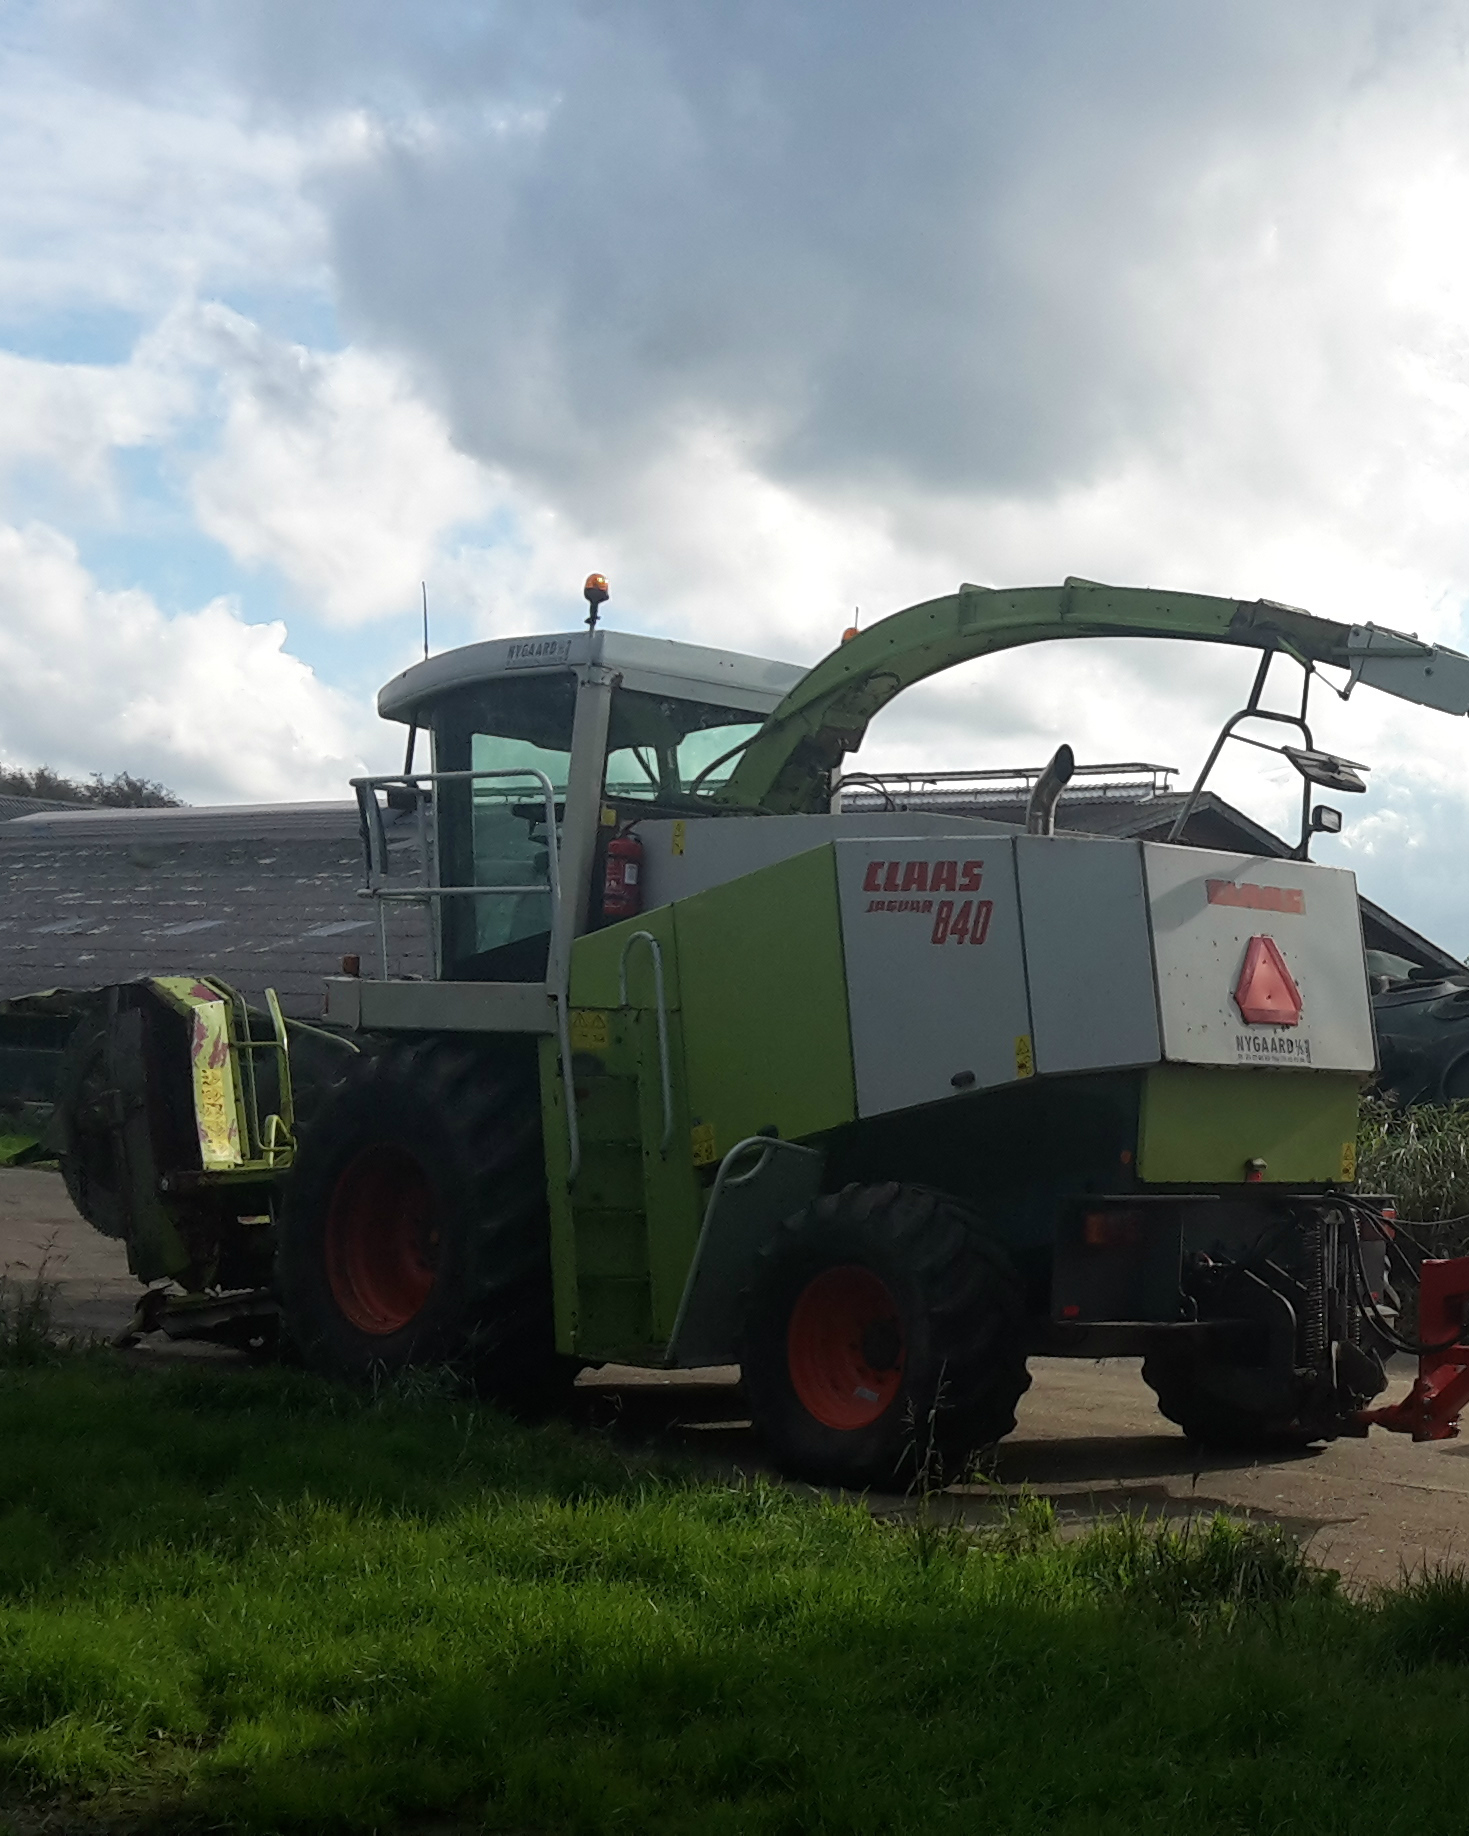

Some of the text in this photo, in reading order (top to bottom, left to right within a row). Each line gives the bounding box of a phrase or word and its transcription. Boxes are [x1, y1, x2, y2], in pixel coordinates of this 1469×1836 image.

[506, 641, 557, 659] NYGAARD
[862, 860, 984, 892] CLAAS
[864, 899, 993, 945] JAGUAR 840
[1235, 1035, 1294, 1054] NYGAARD
